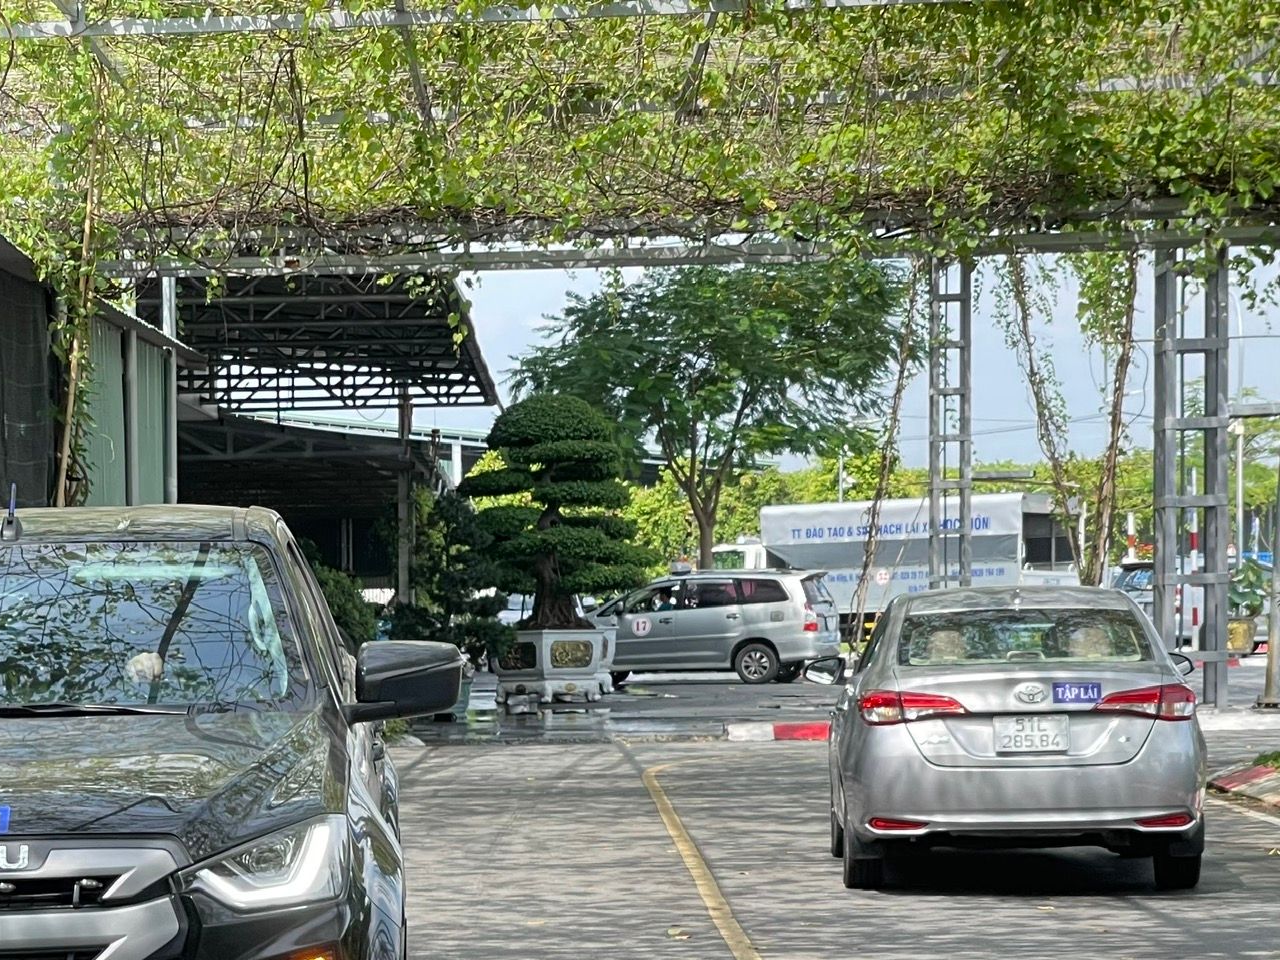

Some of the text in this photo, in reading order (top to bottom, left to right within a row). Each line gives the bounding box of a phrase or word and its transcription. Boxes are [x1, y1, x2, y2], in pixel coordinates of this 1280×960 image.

[636, 621, 647, 631] 17
[1056, 683, 1098, 701] TẬP LÁI
[1015, 718, 1048, 733] 51L
[1002, 734, 1061, 749] 285.84
